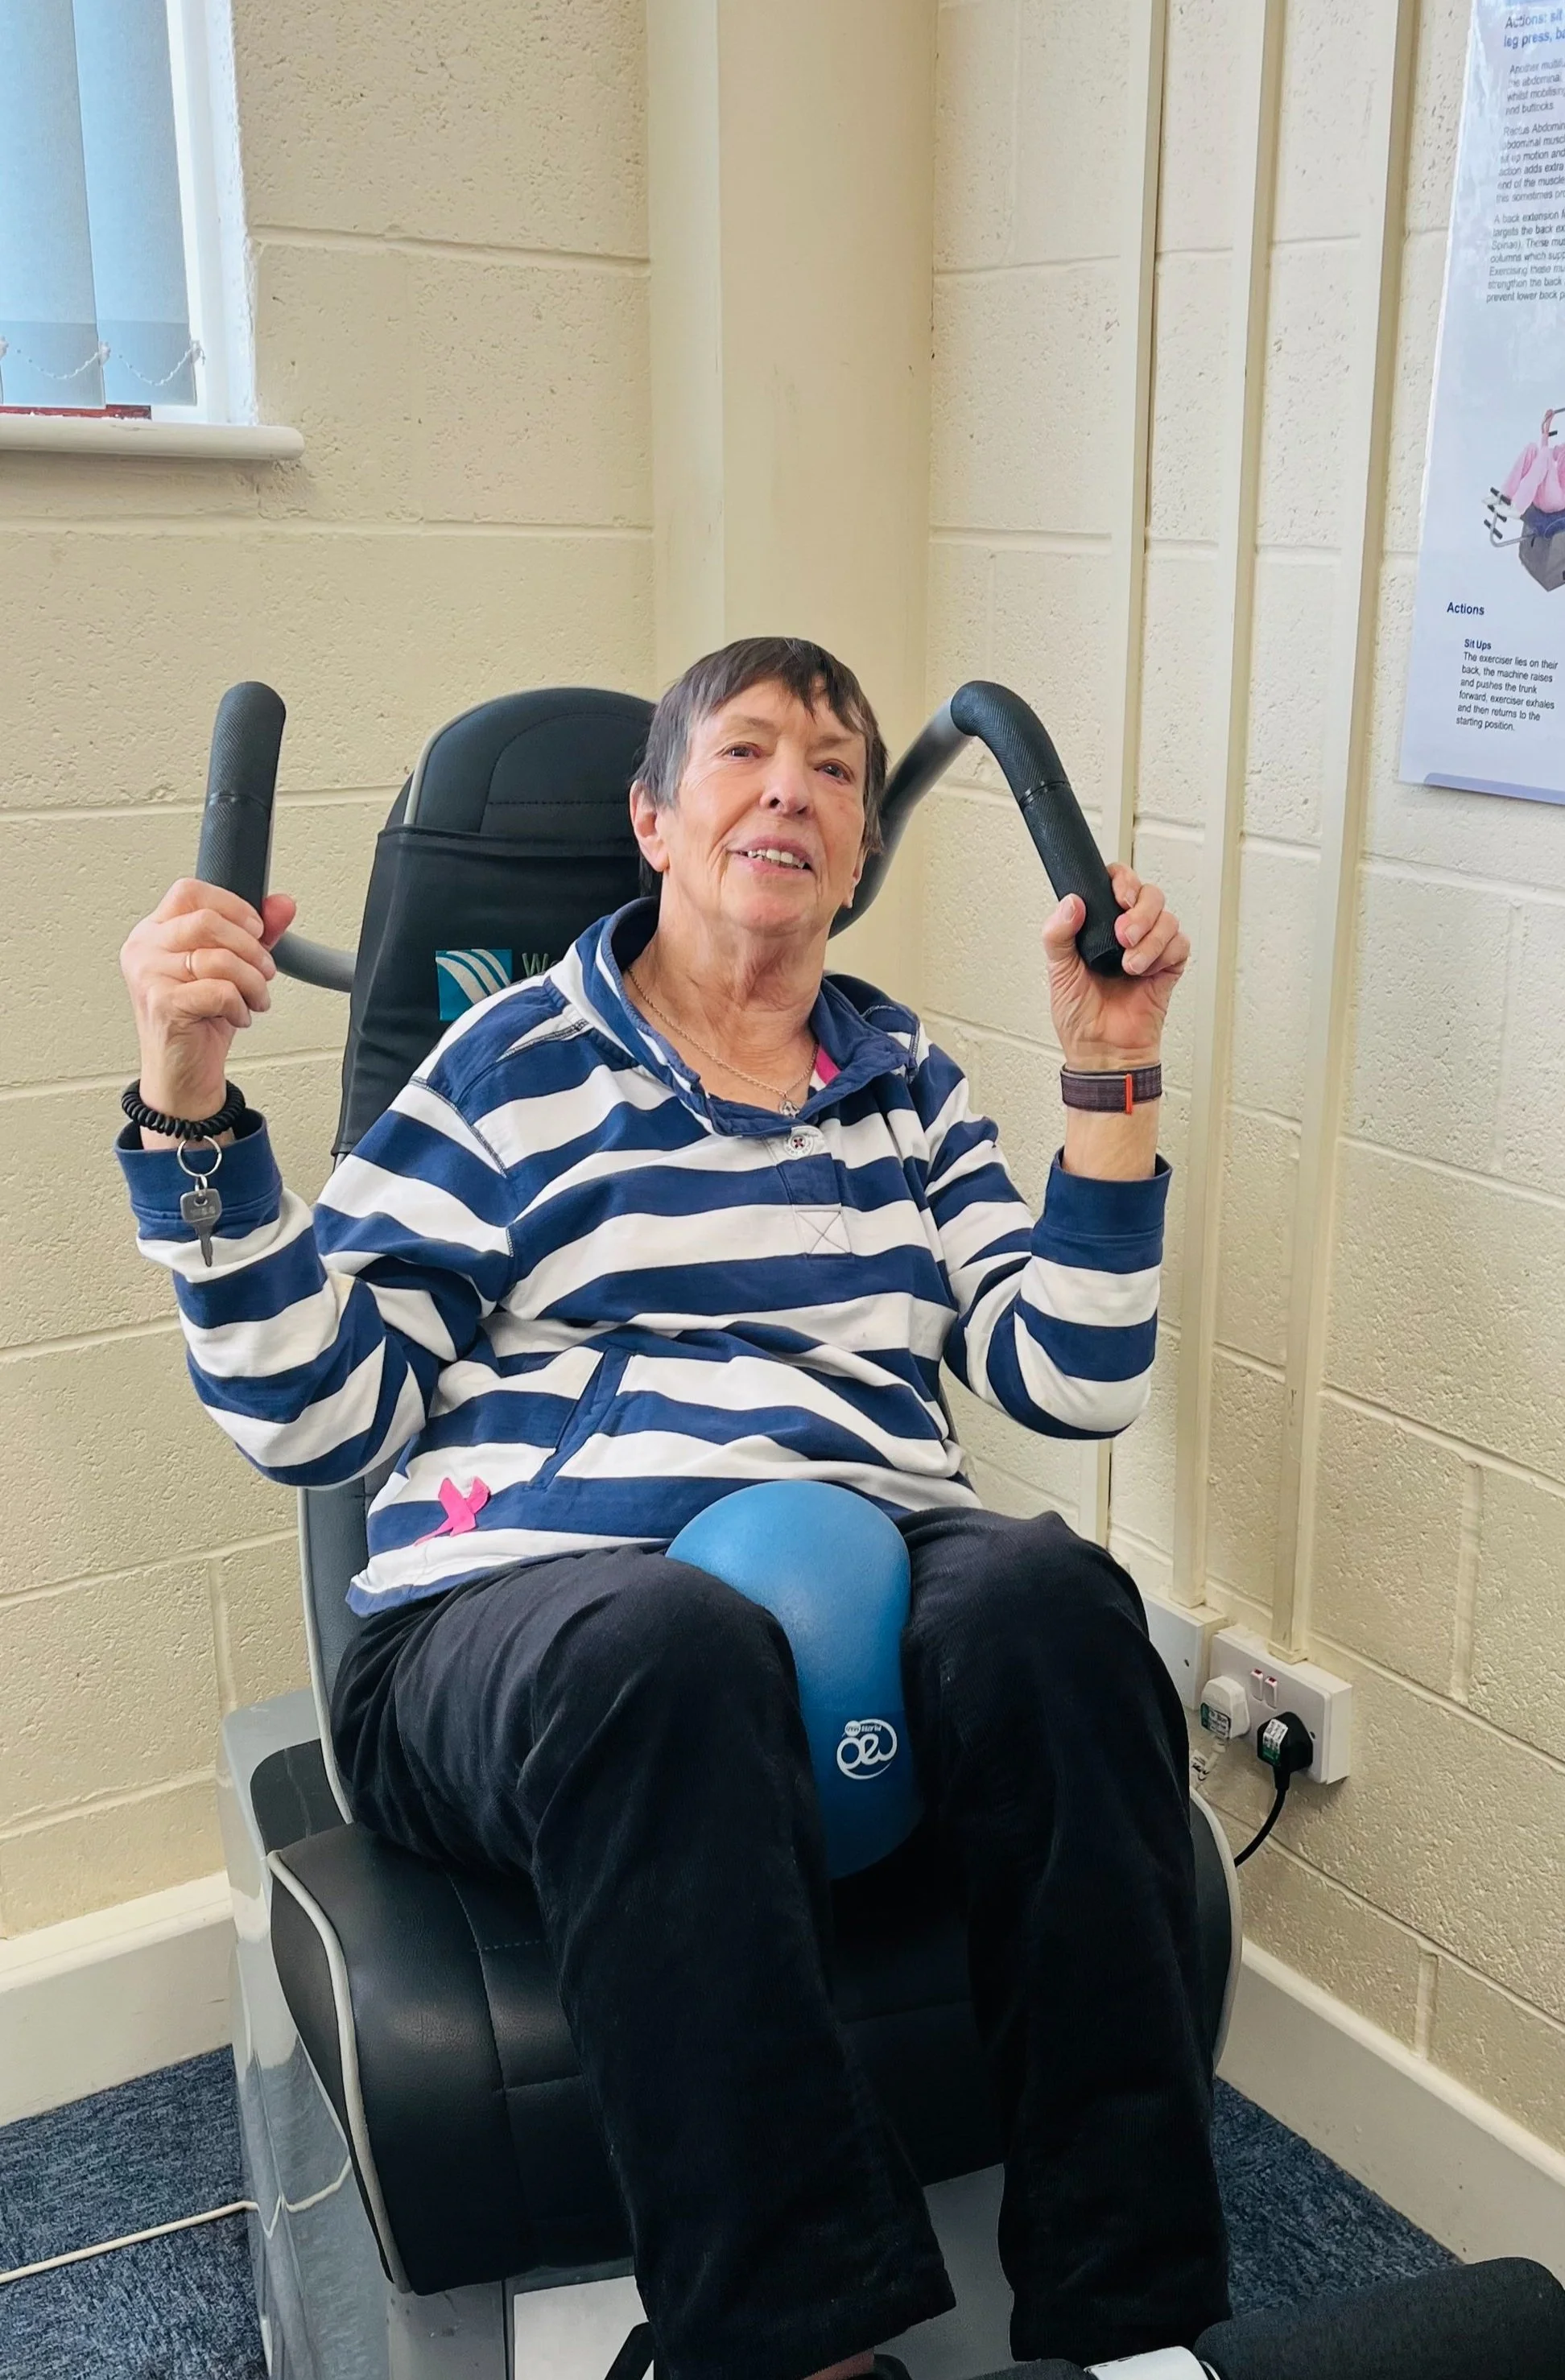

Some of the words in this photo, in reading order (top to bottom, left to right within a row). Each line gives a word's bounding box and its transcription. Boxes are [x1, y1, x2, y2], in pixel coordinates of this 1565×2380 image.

[1504, 34, 1519, 49] leg
[1522, 32, 1552, 48] press,
[1522, 151, 1548, 161] motion
[1524, 163, 1542, 174] adds
[1544, 161, 1564, 172] extra
[1524, 177, 1535, 187] the
[1496, 194, 1509, 203] this
[1502, 212, 1519, 223] back
[1521, 225, 1534, 235] the
[1535, 224, 1553, 234] back
[1526, 238, 1550, 249] These
[1524, 251, 1546, 261] which
[1489, 266, 1528, 277] Exercising
[1530, 265, 1551, 274] these
[1530, 278, 1542, 287] the
[1543, 276, 1562, 287] back
[1486, 291, 1515, 303] prevent
[1517, 290, 1538, 301] lower
[1538, 290, 1558, 300] back
[1447, 602, 1485, 616] Actions
[1464, 638, 1475, 649] Sit
[1476, 640, 1492, 651] Ups
[1464, 651, 1477, 662] The
[1479, 654, 1513, 666] exerciser
[1514, 656, 1528, 667] lies
[1529, 659, 1539, 668] on
[1541, 659, 1559, 670] their
[1461, 664, 1481, 677] back,
[1483, 666, 1495, 677] the
[1497, 668, 1529, 681] machine
[1530, 673, 1553, 683] raises
[1460, 678, 1475, 688] and
[1476, 680, 1503, 691] pushes
[1505, 682, 1517, 693] the
[1518, 684, 1538, 695] trunk
[1459, 689, 1488, 703] forward,
[1489, 694, 1524, 706] exerciser
[1526, 698, 1555, 710] exhales
[1457, 703, 1472, 713] and
[1473, 704, 1489, 716] then
[1491, 707, 1518, 719] returns
[1519, 709, 1527, 720] to
[1528, 709, 1541, 721] the
[1456, 716, 1483, 730] starting
[1484, 720, 1515, 732] position.
